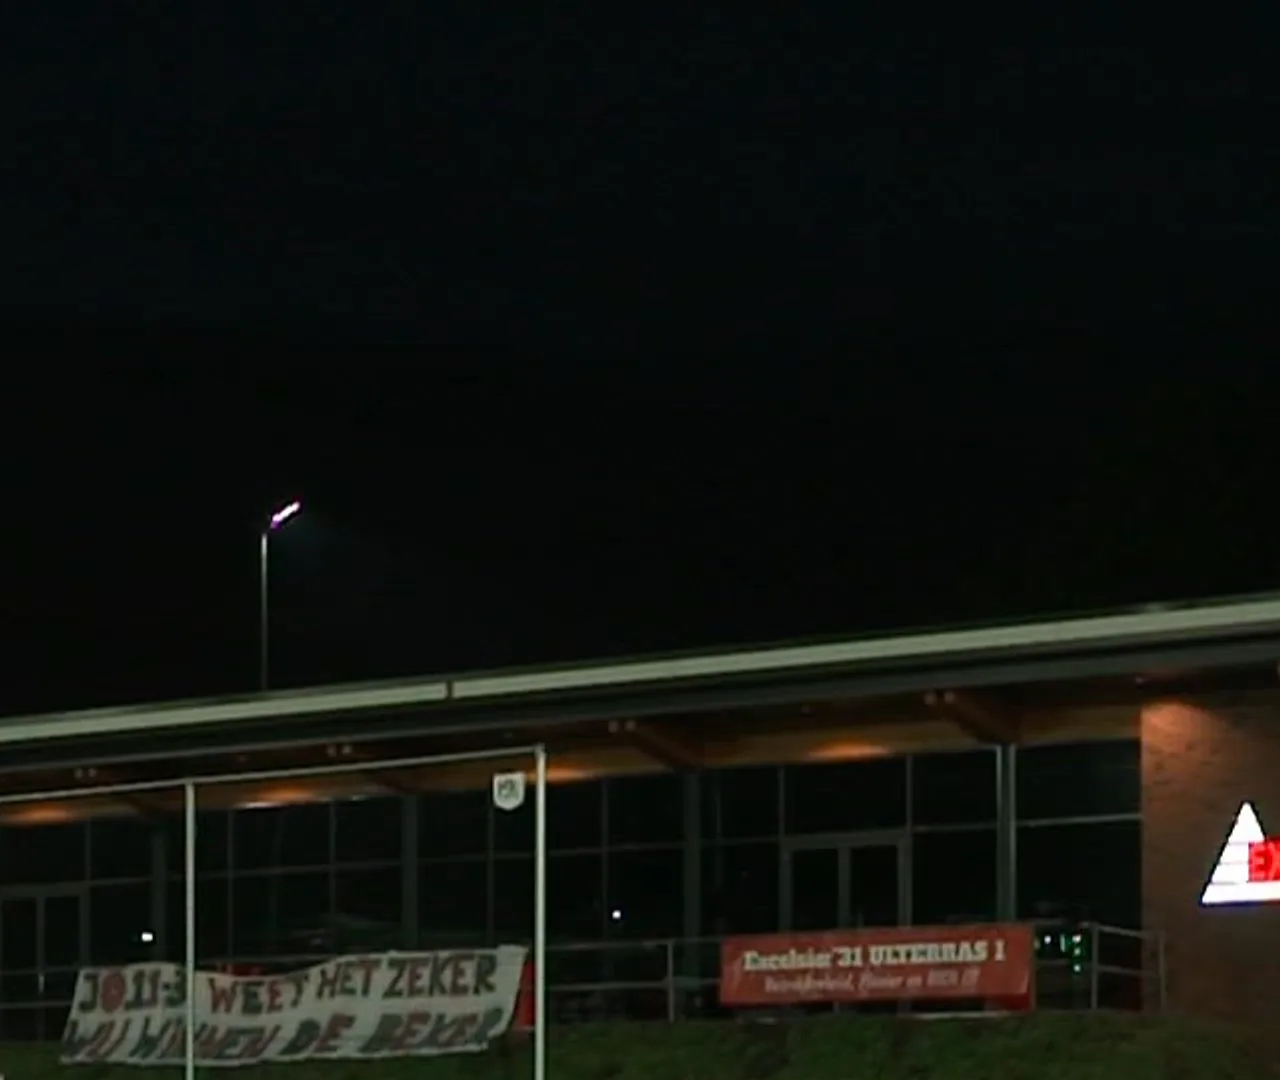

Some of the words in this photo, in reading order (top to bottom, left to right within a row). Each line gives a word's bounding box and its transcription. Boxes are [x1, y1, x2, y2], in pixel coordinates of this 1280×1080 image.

[208, 974, 306, 1014] WEET
[320, 960, 383, 999] HET
[384, 953, 497, 998] ZEKER
[280, 1012, 355, 1056] DE
[363, 1007, 506, 1053] BEKER
